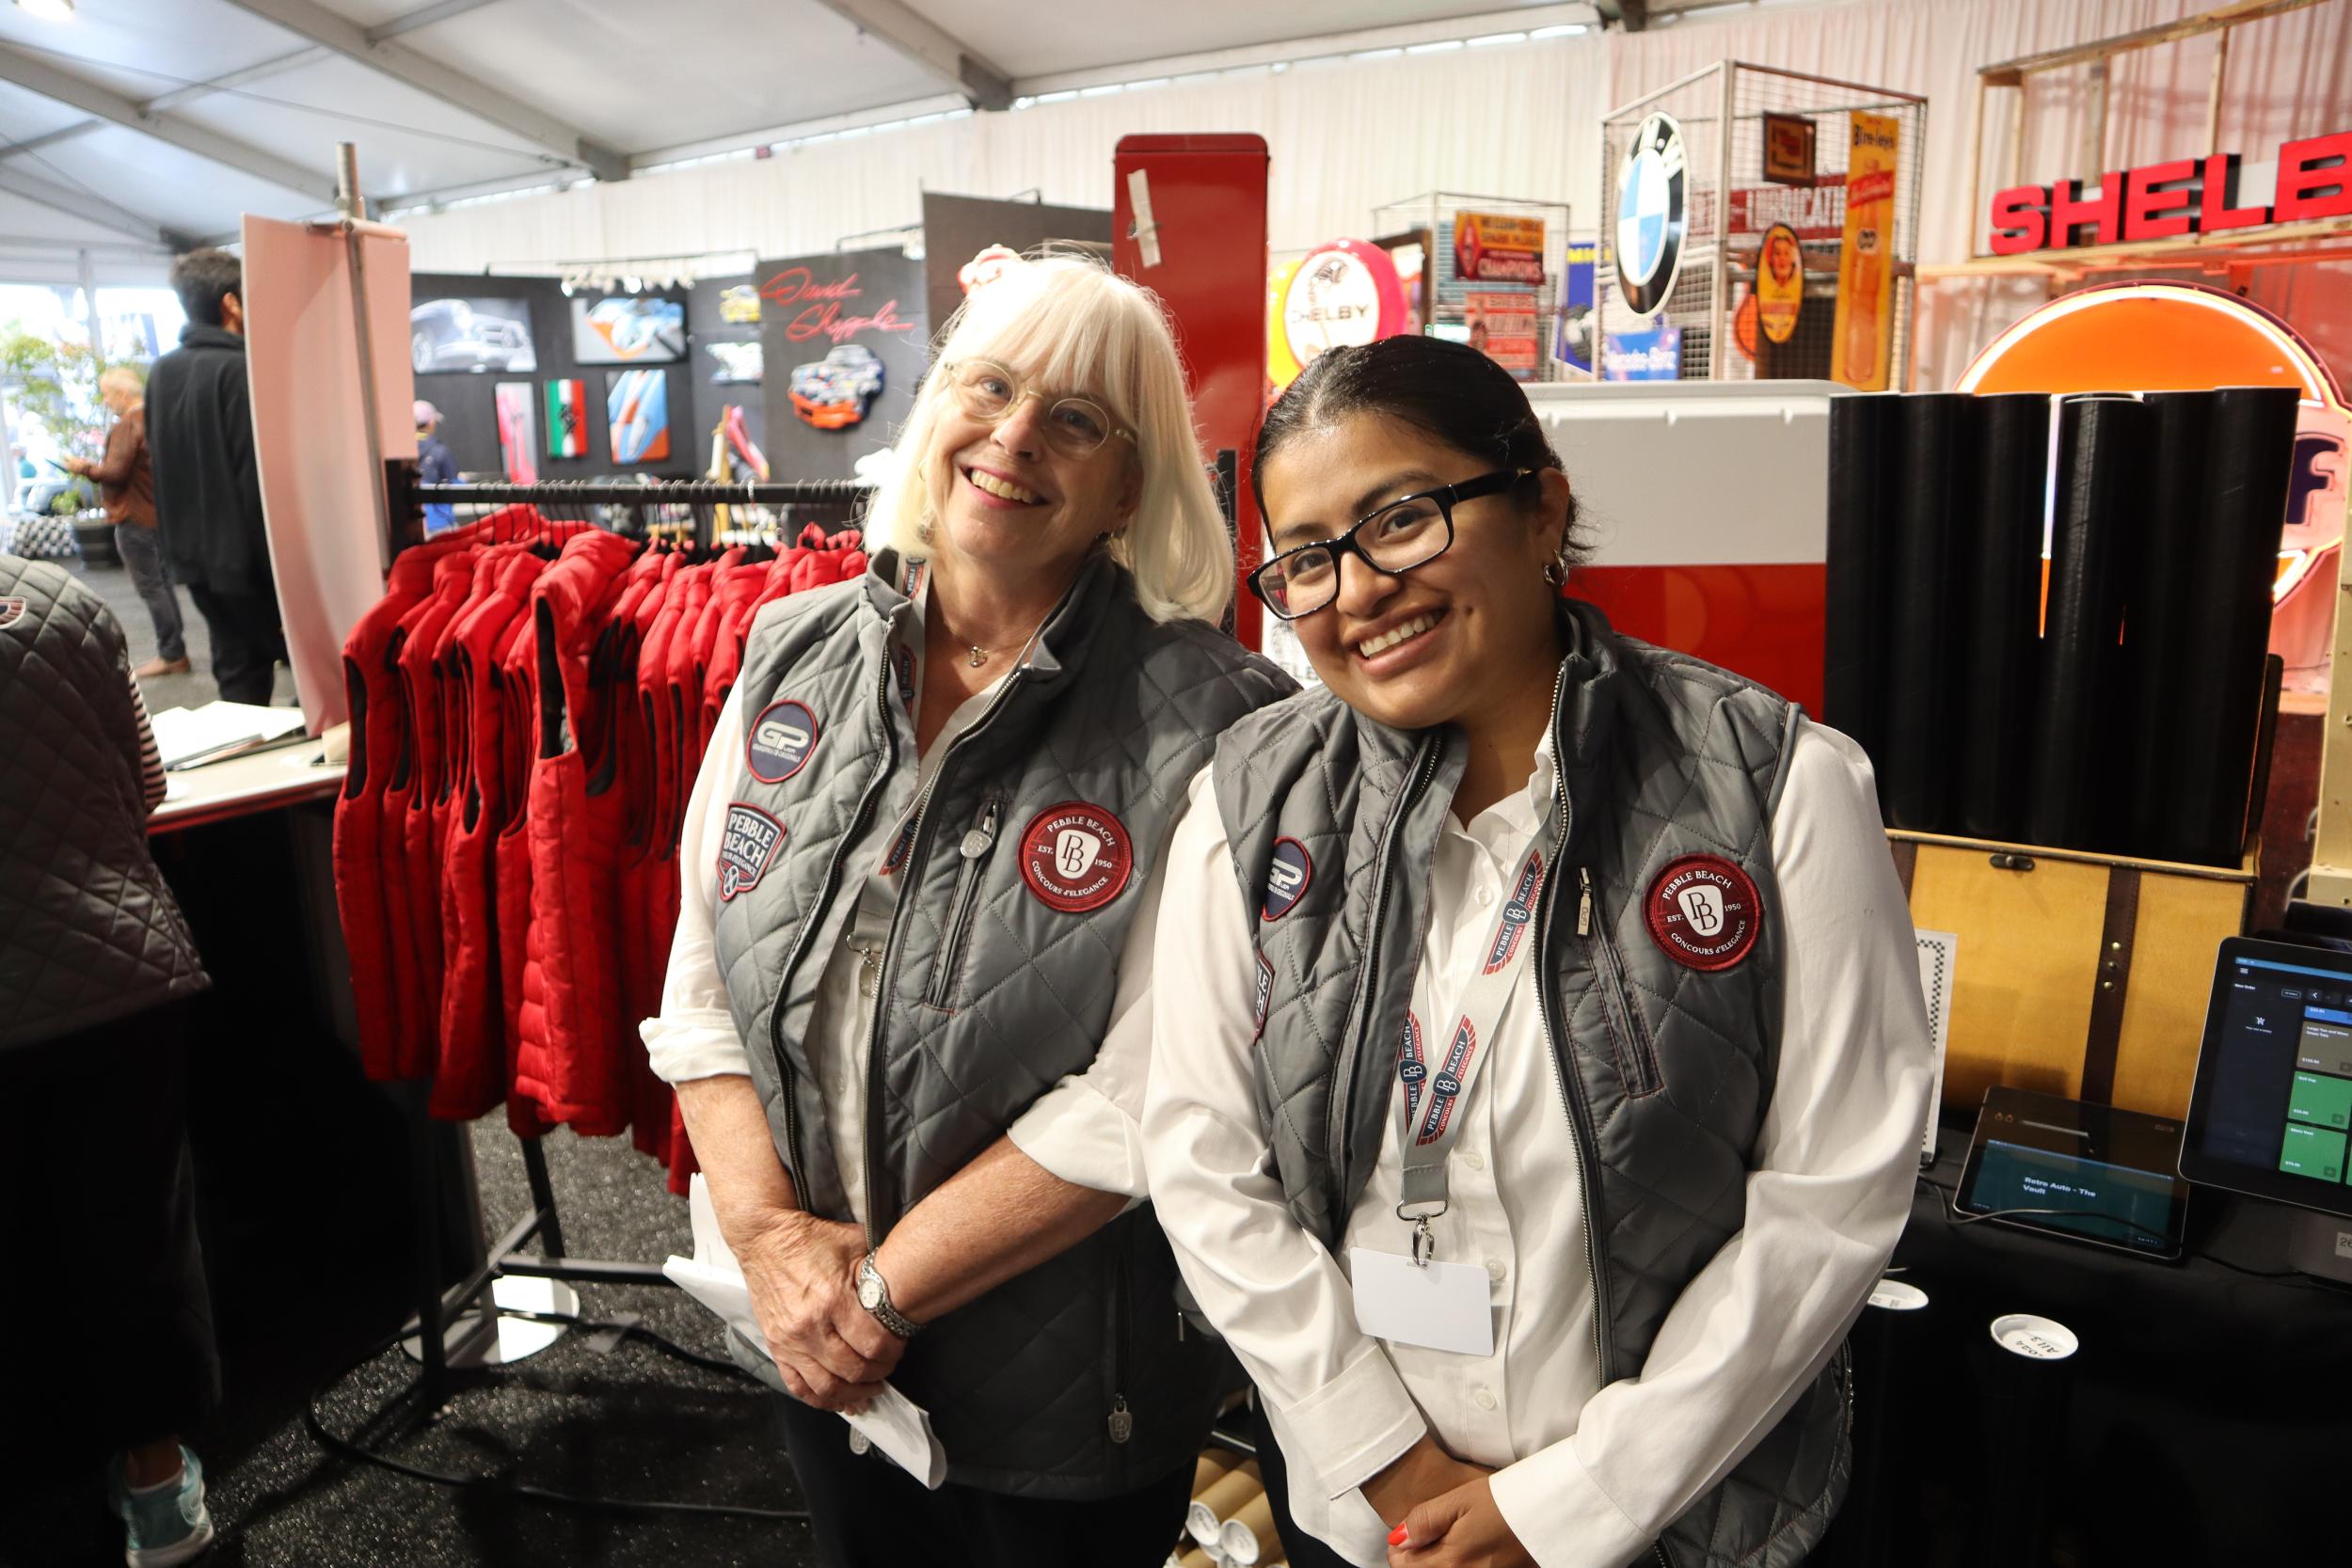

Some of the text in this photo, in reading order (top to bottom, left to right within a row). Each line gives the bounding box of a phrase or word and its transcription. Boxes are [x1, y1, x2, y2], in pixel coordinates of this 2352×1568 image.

[1990, 131, 2352, 256] SHELB
[727, 813, 774, 848] PEBBLE
[1046, 816, 1117, 847] PEBBLE BEACH
[723, 831, 766, 868] BEACH
[1037, 844, 1055, 855] EST.
[1094, 858, 1113, 869] 1950
[1031, 860, 1064, 896] CONCOURS
[1518, 874, 1534, 902] BEACH
[1661, 870, 1732, 900] PEBBLE BEACH
[1666, 913, 1685, 923] EST.
[1724, 903, 1741, 912] 1950
[1496, 925, 1515, 958] PEBBLE
[1671, 919, 1746, 956] CONCOURS d'ELEGANCE
[1405, 1025, 1413, 1058] BEACH
[1447, 1040, 1466, 1073] BEACH
[1427, 1097, 1445, 1131] PEBBLE
[2023, 1184, 2047, 1196] Vault
[2025, 1176, 2049, 1187] Retro
[2050, 1182, 2071, 1192] Auto
[2079, 1188, 2096, 1197] The
